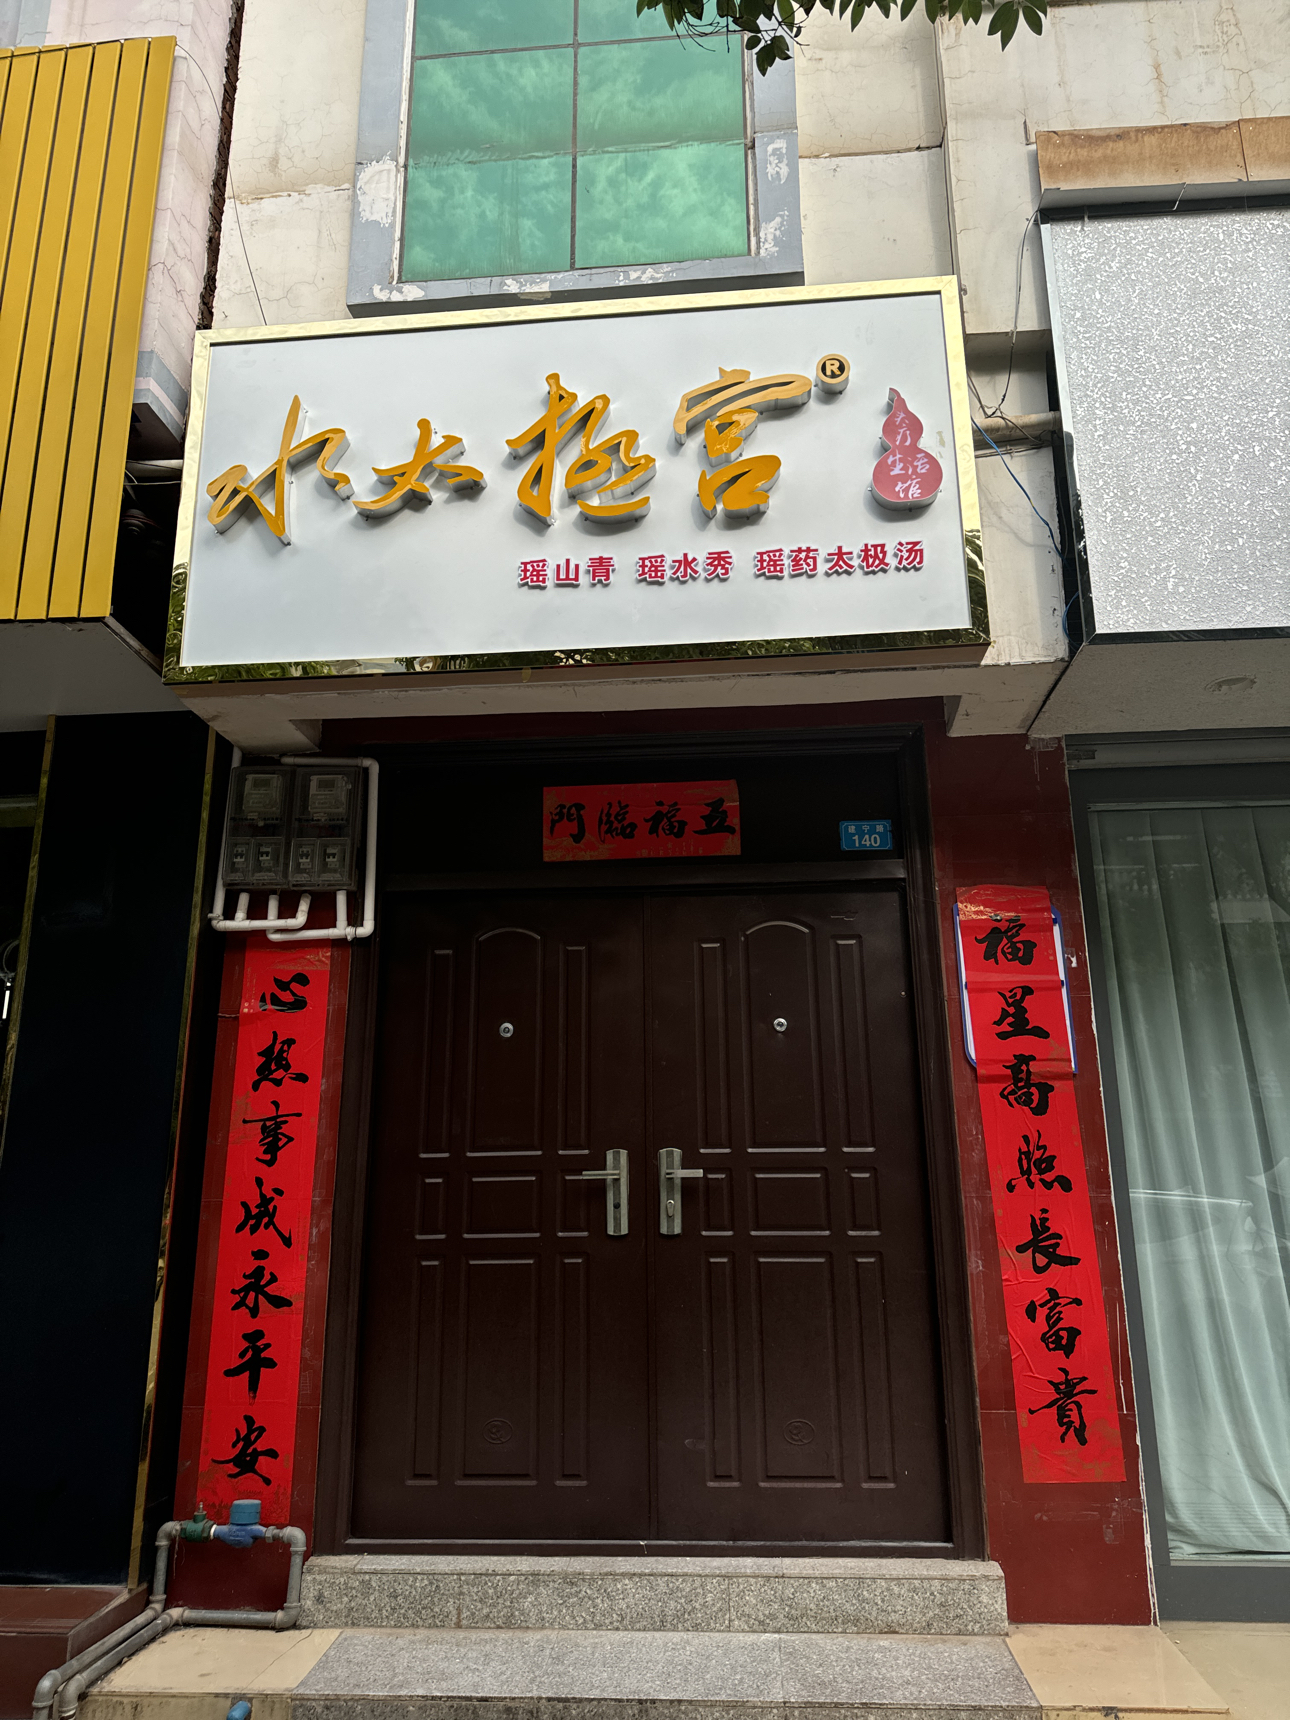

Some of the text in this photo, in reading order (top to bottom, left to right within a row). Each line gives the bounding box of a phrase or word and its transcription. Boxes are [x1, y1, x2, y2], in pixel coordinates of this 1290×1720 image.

[518, 540, 926, 586] 瑶山青 瑶水秀 瑶药太极汤
[847, 825, 885, 834] 建宁路
[852, 834, 880, 847] 140
[210, 972, 310, 1486] 心想事成永平安
